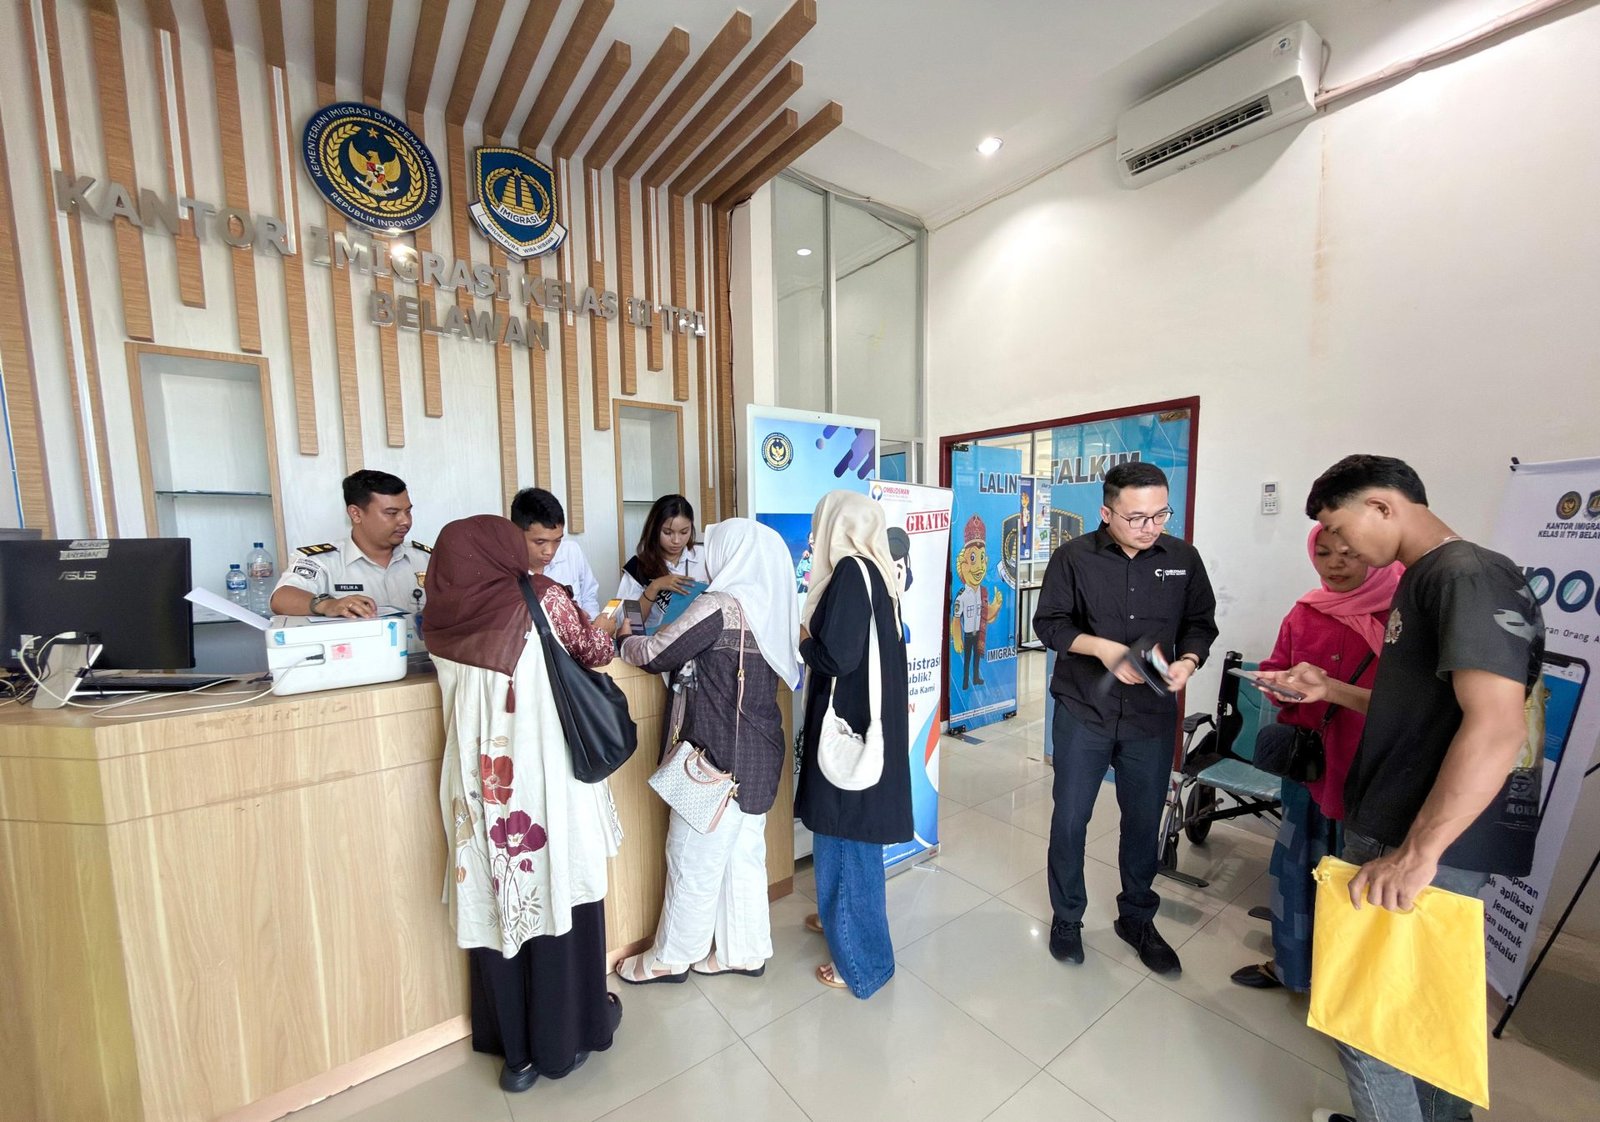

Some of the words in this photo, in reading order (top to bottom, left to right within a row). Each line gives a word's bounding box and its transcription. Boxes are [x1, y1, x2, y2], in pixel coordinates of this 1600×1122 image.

[307, 114, 329, 177] KEMENTERIAN
[328, 106, 371, 120] IMIGRASI
[374, 112, 397, 128] DAN
[397, 126, 440, 206] PEMASYARAKATAN
[330, 191, 375, 224] REPUBLIK
[377, 213, 424, 228] INDONESIA
[500, 207, 539, 224] IMIGRASI
[54, 170, 295, 257] KANTOR
[310, 226, 512, 301] IMIGRASI
[521, 273, 619, 322] KELAS
[504, 240, 520, 252] PURA
[371, 291, 550, 351] BELAWAN
[906, 512, 949, 532] GRATIS
[1546, 522, 1574, 530] KANTOR
[1574, 522, 1600, 531] IMIGRA
[1538, 530, 1559, 538] KELAS
[1567, 531, 1578, 539] TPI
[59, 570, 98, 581] ASUS
[1563, 629, 1589, 643] Orang
[907, 653, 940, 671] nistrasi
[987, 647, 1016, 662] IMIGRAS
[908, 671, 932, 683] blik?
[909, 686, 919, 696] da
[919, 683, 935, 694] Kami
[1508, 876, 1539, 900] poran
[1500, 886, 1535, 916] aplikasi
[1497, 923, 1522, 948] untuk
[1486, 934, 1518, 963] melalui
